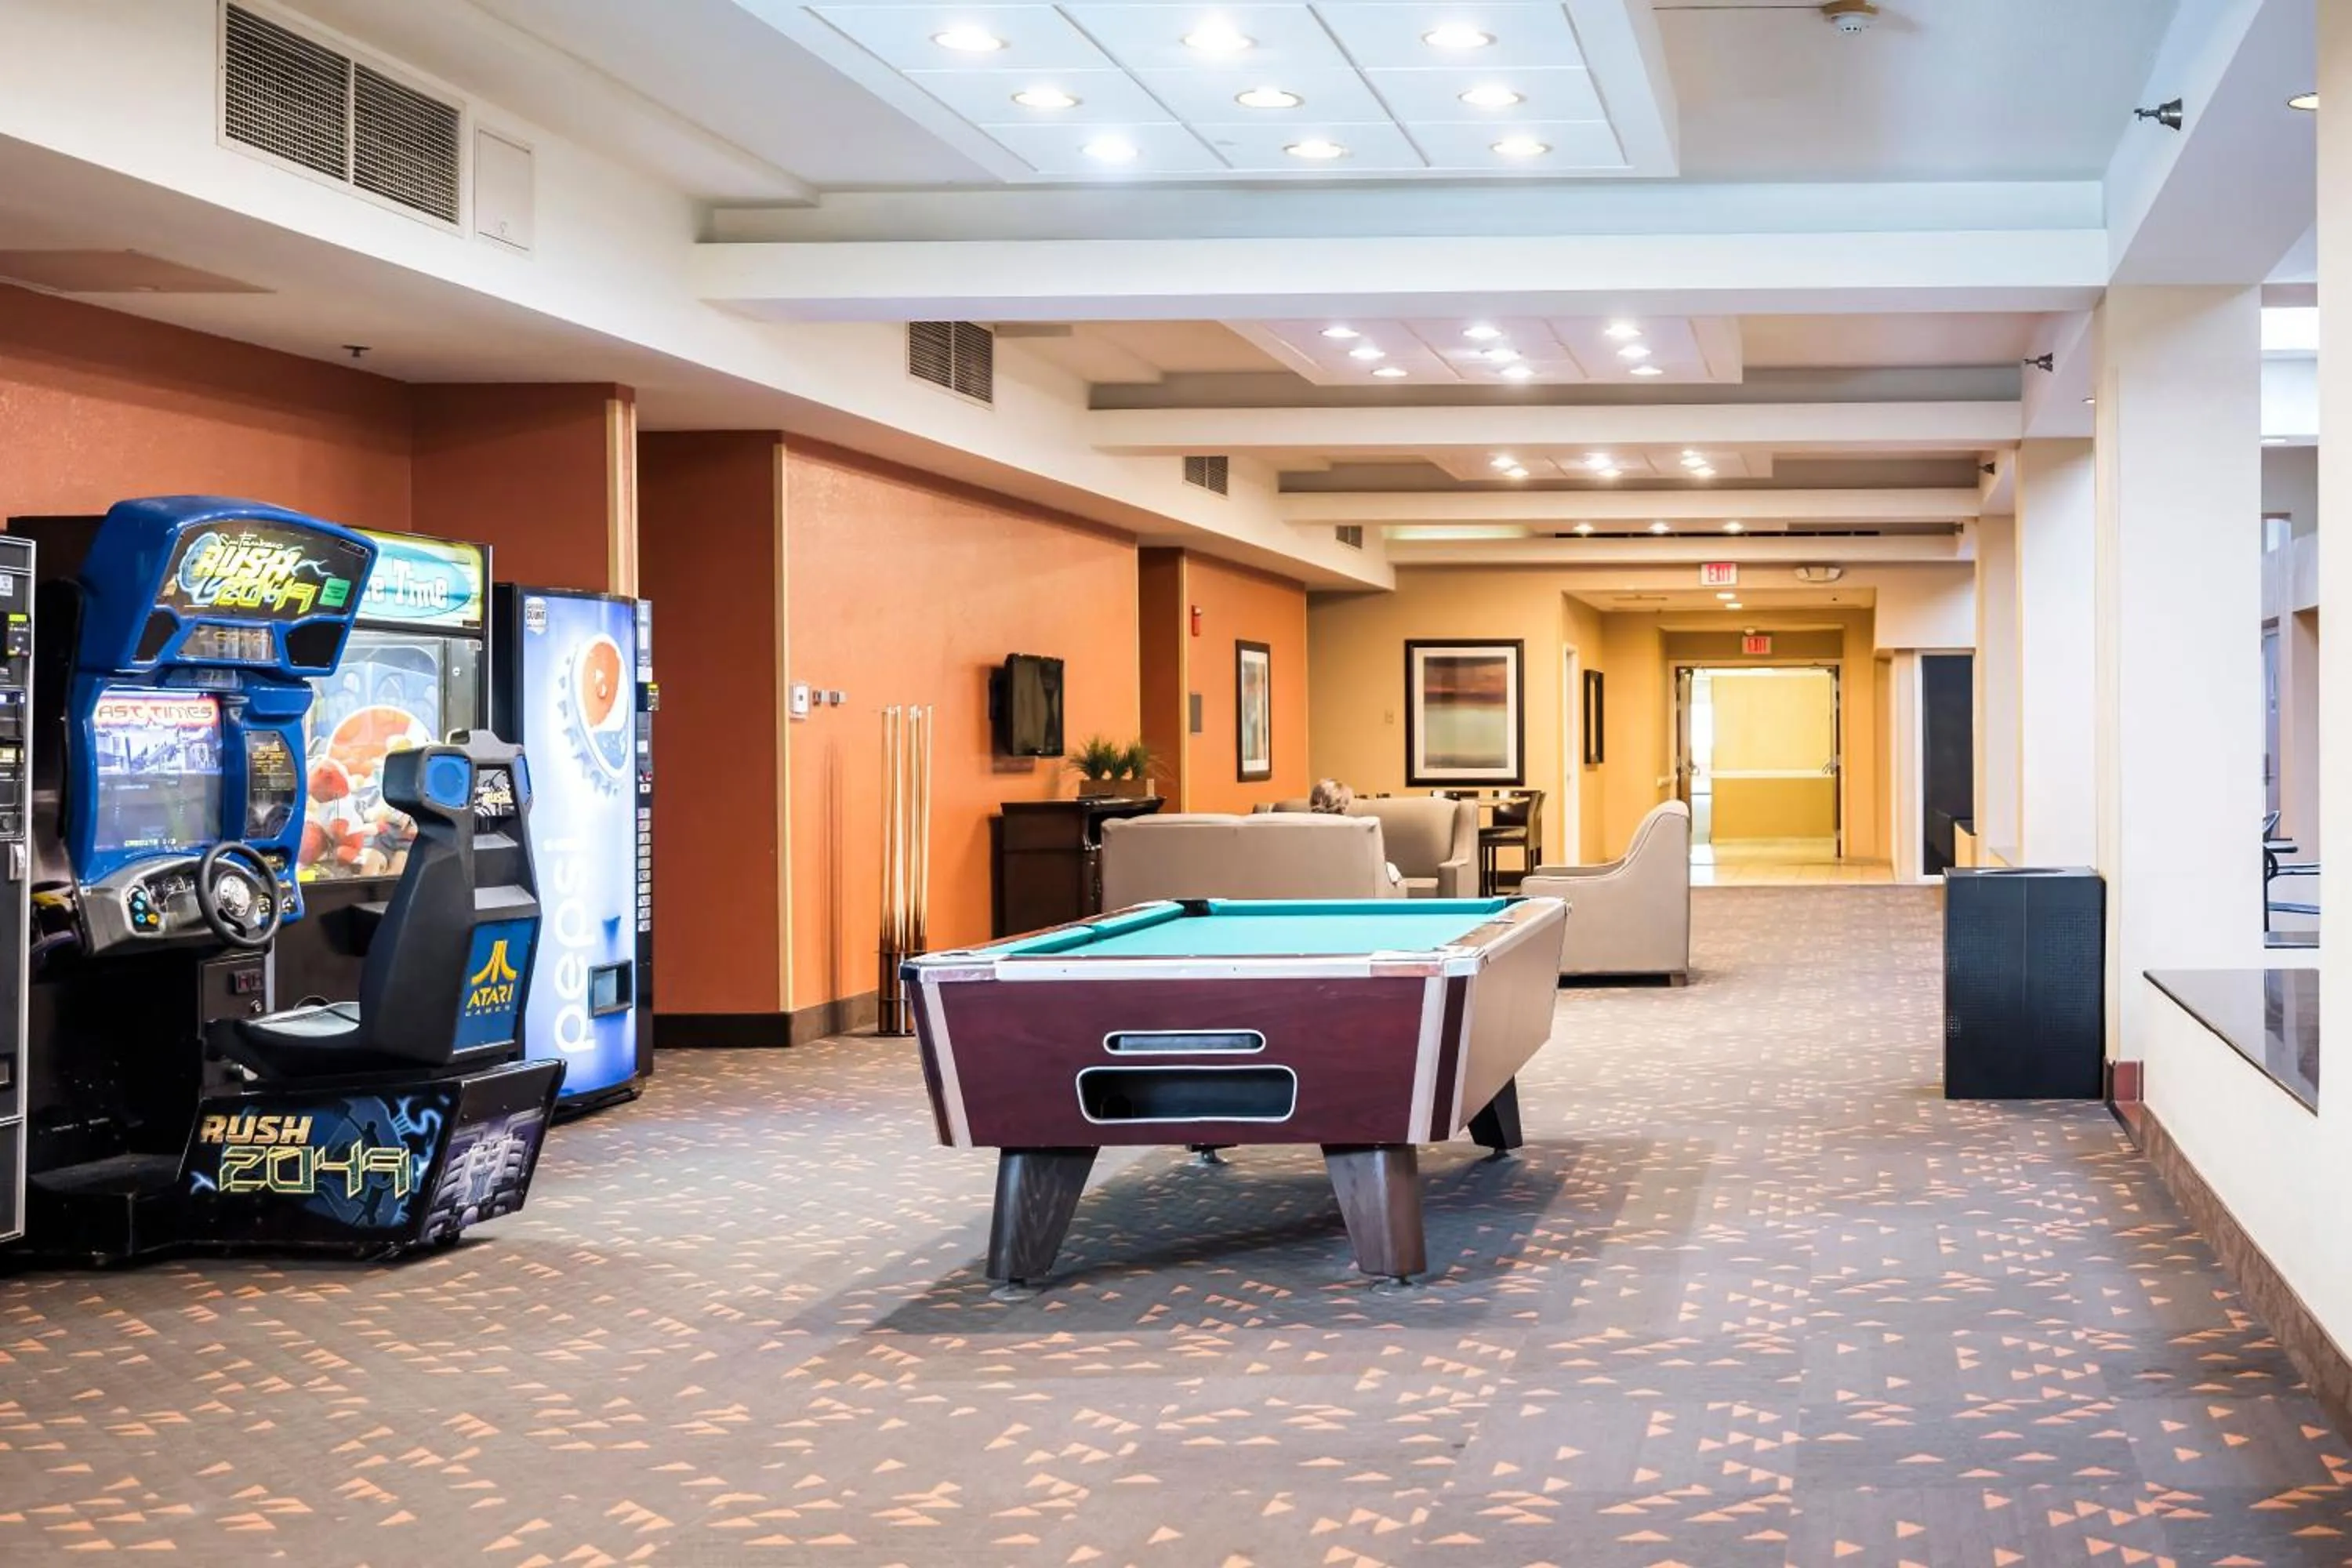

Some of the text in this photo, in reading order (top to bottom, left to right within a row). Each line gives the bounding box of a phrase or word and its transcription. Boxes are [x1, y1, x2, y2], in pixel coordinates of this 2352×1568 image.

[194, 546, 302, 579] RUSH
[1706, 564, 1731, 583] EXIT
[214, 576, 317, 615] 2049
[393, 557, 449, 610] Time
[1747, 637, 1767, 653] EXIT
[150, 705, 212, 719] TIMES
[543, 838, 597, 1054] pepsi
[466, 982, 514, 1009] ATARI
[200, 1115, 314, 1145] RUSH
[219, 1139, 411, 1200] 2049
